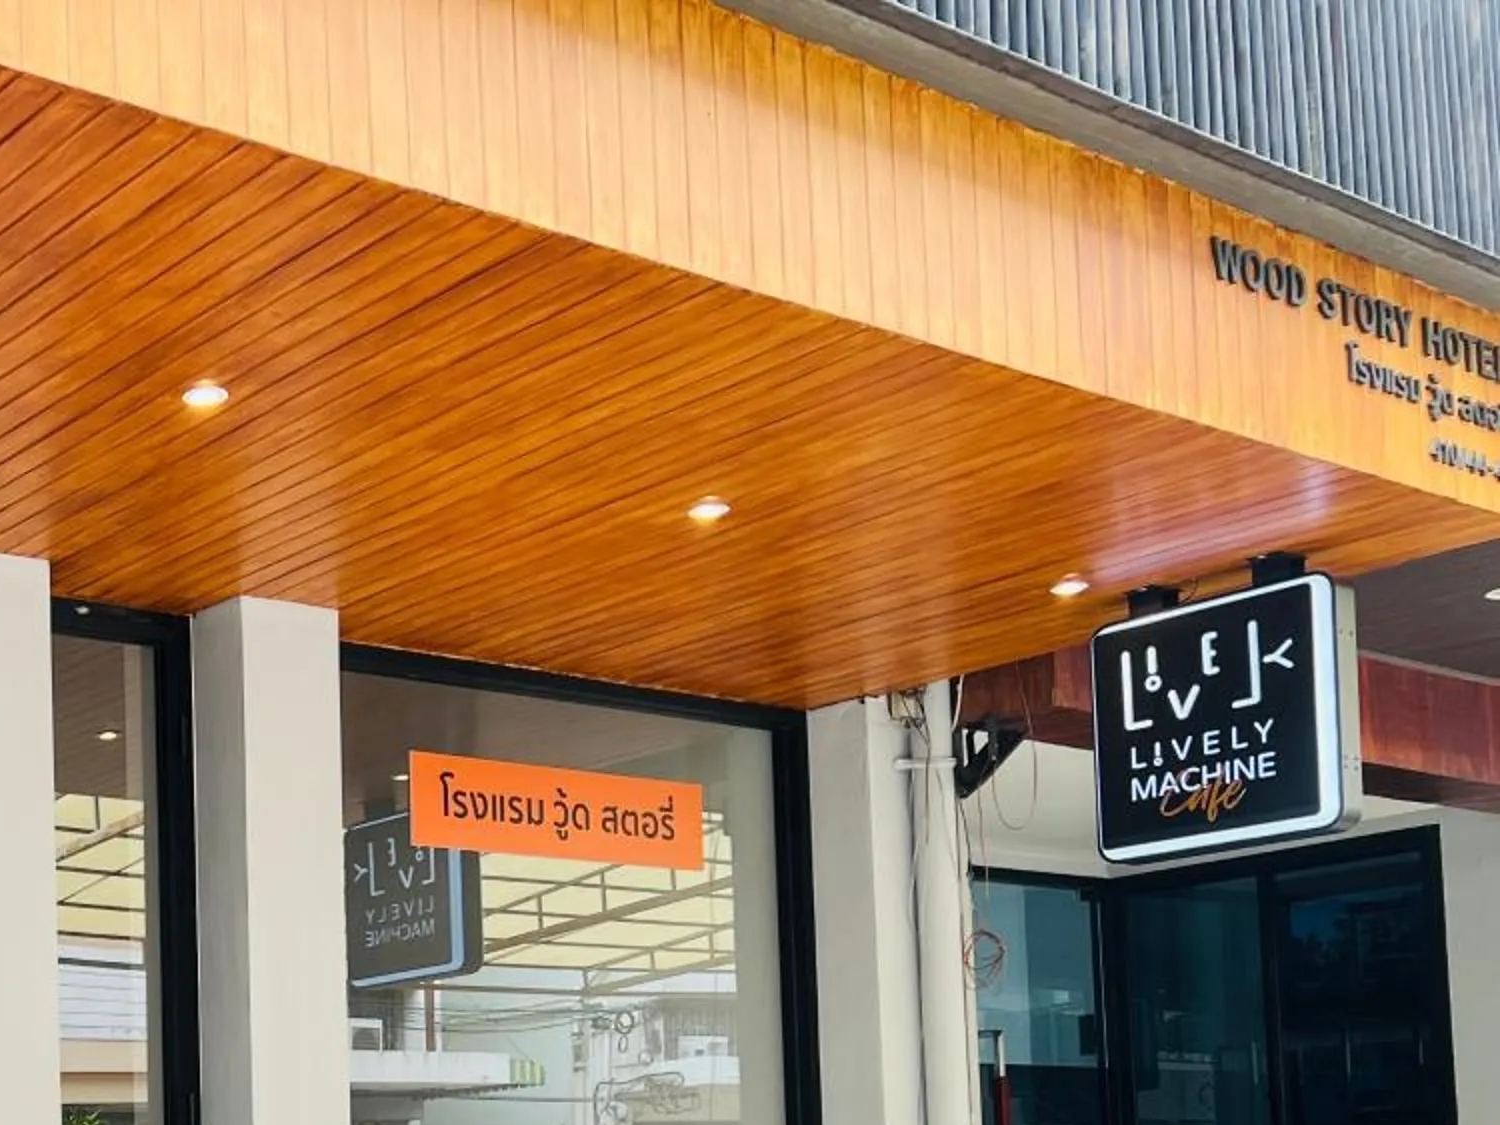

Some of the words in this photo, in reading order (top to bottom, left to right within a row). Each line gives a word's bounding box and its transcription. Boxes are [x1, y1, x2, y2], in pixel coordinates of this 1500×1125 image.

[1209, 235, 1307, 307] WOOD
[1316, 278, 1413, 348] STORY
[439, 771, 545, 827] โรงแรม
[553, 787, 591, 841] วู้ด
[601, 796, 675, 842] สตอรี่
[1130, 752, 1276, 801] MACHINE
